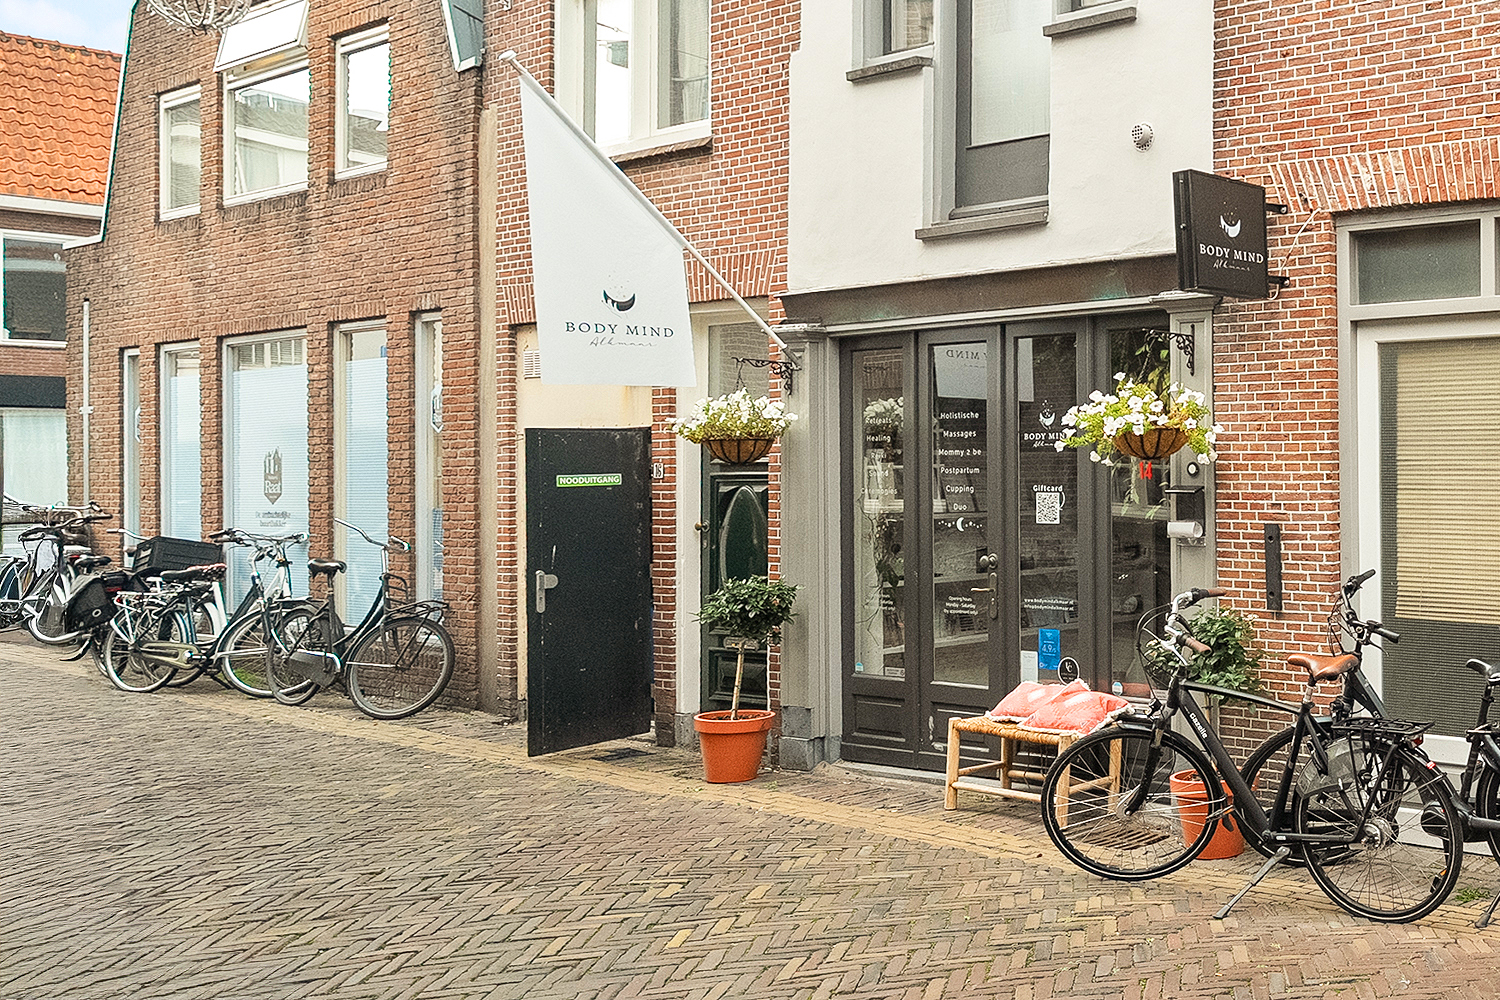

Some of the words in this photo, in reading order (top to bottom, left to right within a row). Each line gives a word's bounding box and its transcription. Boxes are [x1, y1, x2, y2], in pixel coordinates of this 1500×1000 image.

[1199, 243, 1230, 259] BODY
[1233, 249, 1264, 264] MIND
[565, 321, 618, 334] BODY
[626, 324, 674, 338] MIND
[940, 411, 980, 420] Holistische
[866, 434, 892, 443] Healing
[943, 430, 977, 439] Massages
[1023, 432, 1046, 441] BODY
[1048, 432, 1066, 441] MIN
[938, 448, 964, 458] Mommy
[972, 448, 982, 456] be
[868, 469, 889, 477] Sond
[940, 466, 980, 475] Postpartum
[1139, 461, 1153, 480] 14
[559, 475, 620, 486] NOODUITGANG
[945, 484, 975, 494] Cupping
[1032, 484, 1063, 492] Giftcard
[953, 503, 967, 511] Duo
